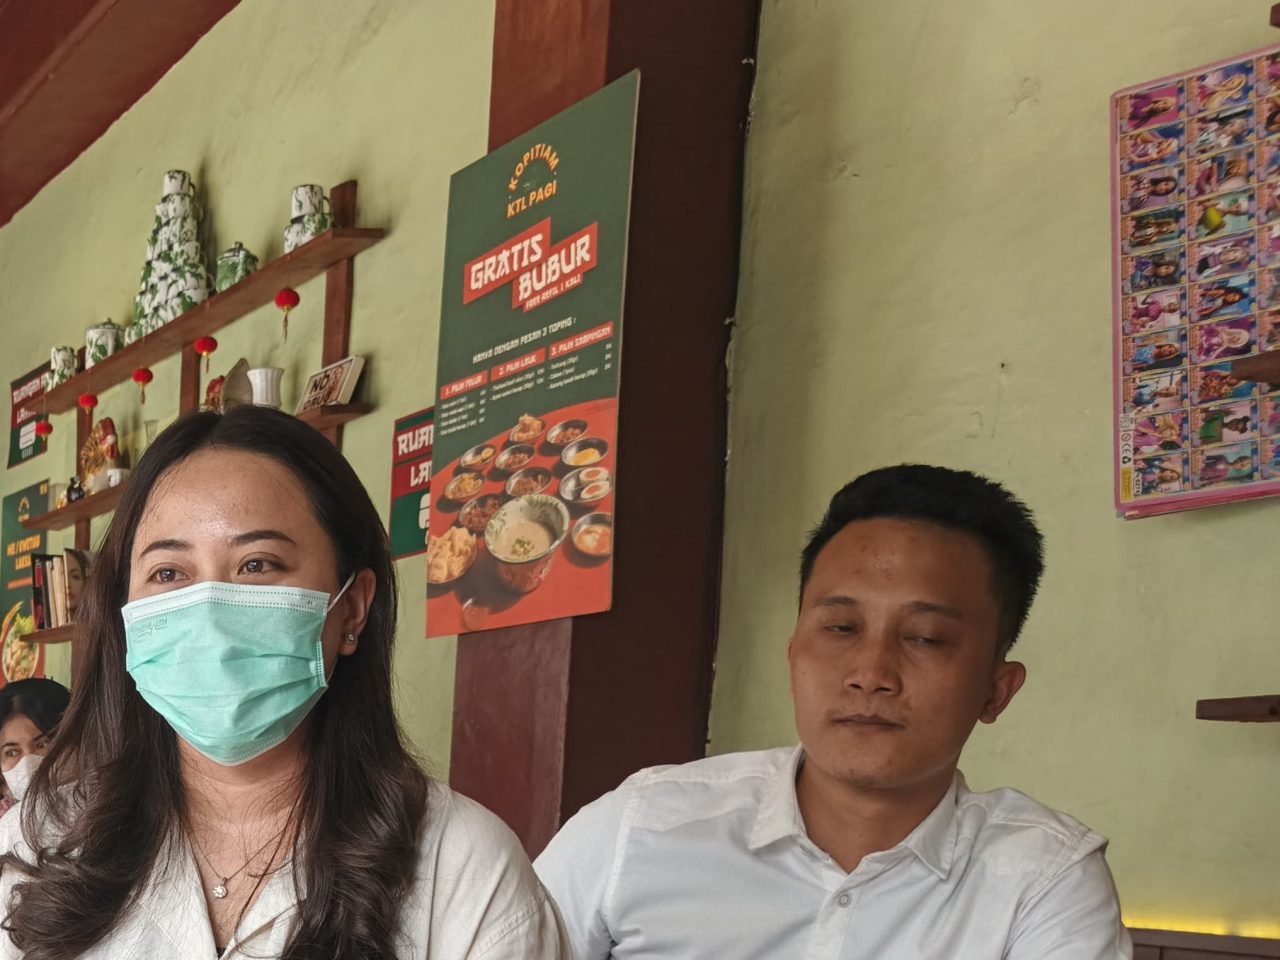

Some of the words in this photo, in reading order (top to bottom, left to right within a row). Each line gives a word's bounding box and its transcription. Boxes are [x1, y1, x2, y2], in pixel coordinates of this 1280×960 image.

[508, 143, 559, 192] KOPITIAM
[506, 196, 527, 218] KTL
[528, 179, 557, 206] PAGI
[470, 233, 543, 290] GRATIS
[518, 234, 590, 301] BUBUR
[520, 329, 542, 345] PESAN
[548, 316, 573, 333] TOPING
